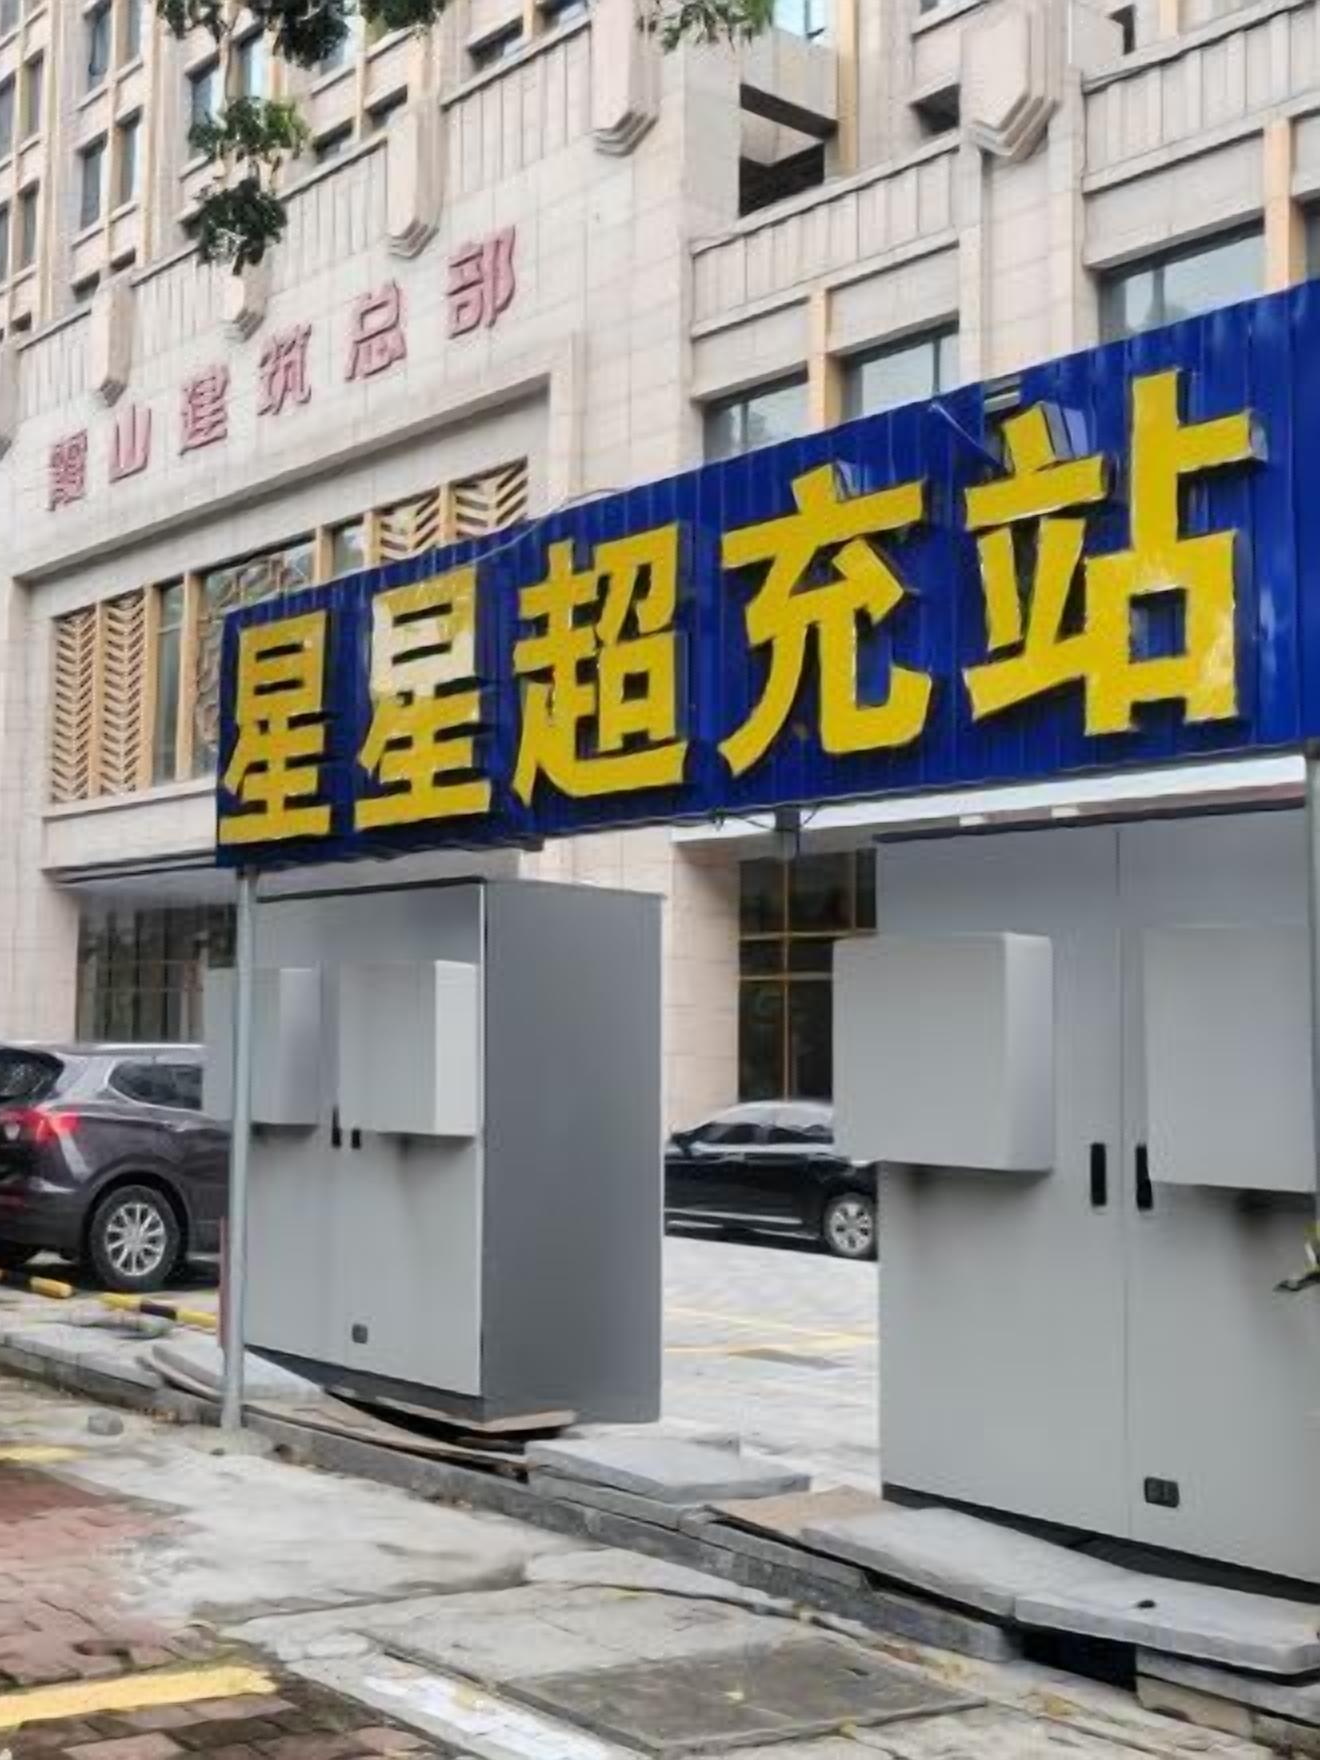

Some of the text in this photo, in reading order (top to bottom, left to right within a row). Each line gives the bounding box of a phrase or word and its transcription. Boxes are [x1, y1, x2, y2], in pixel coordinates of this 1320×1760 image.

[218, 368, 1262, 845] 星星超充站
